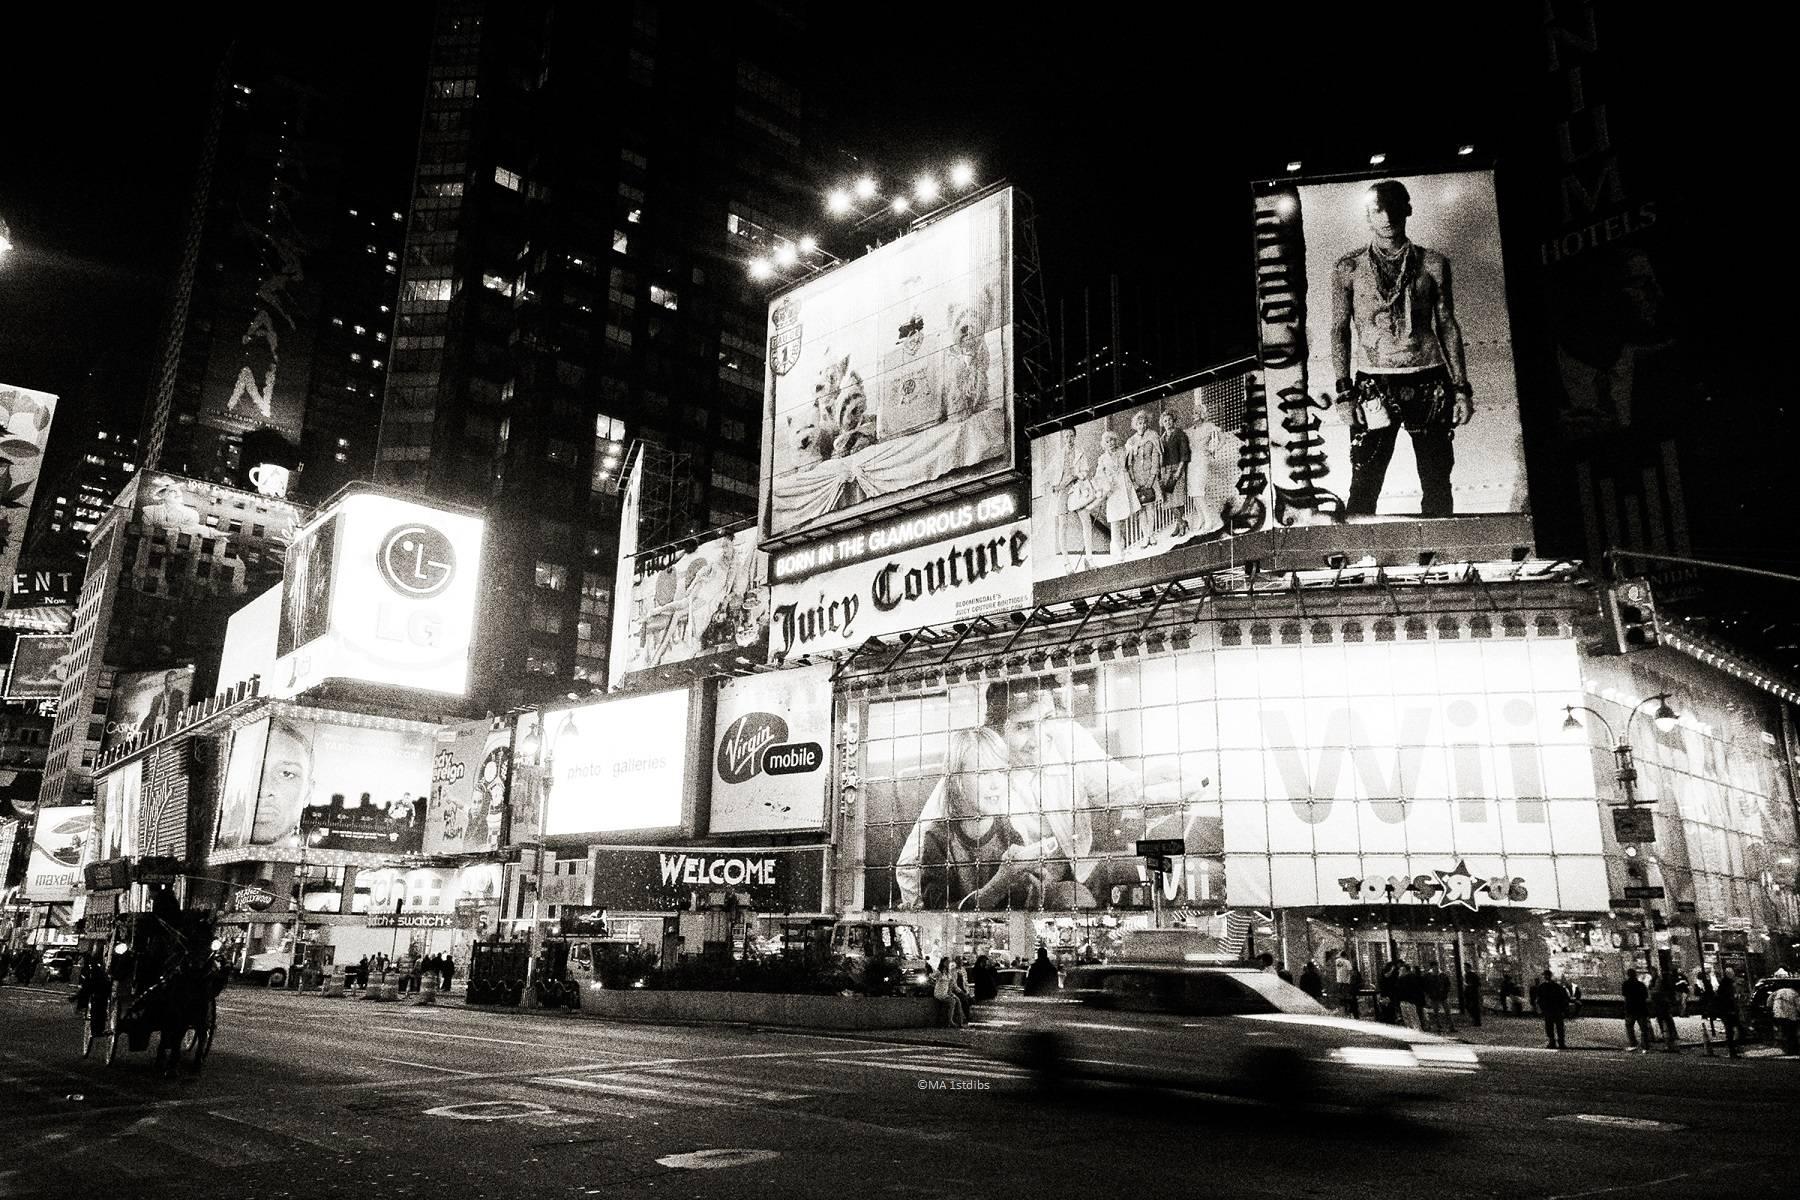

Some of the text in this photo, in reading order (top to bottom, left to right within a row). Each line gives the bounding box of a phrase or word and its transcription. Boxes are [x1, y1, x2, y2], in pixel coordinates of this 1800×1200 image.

[1541, 201, 1657, 266] HOTELS
[776, 492, 1016, 578] BORN IN THE GLAMOROUS USA
[773, 527, 1030, 663] Juicy Couture
[567, 755, 668, 781] photo galleries
[724, 715, 816, 775] Virgin mobile
[1258, 698, 1546, 825] Wii
[35, 871, 75, 887] maxell
[659, 852, 777, 887] WELCOME
[1337, 873, 1437, 902] TOYS
[1488, 875, 1529, 902] US
